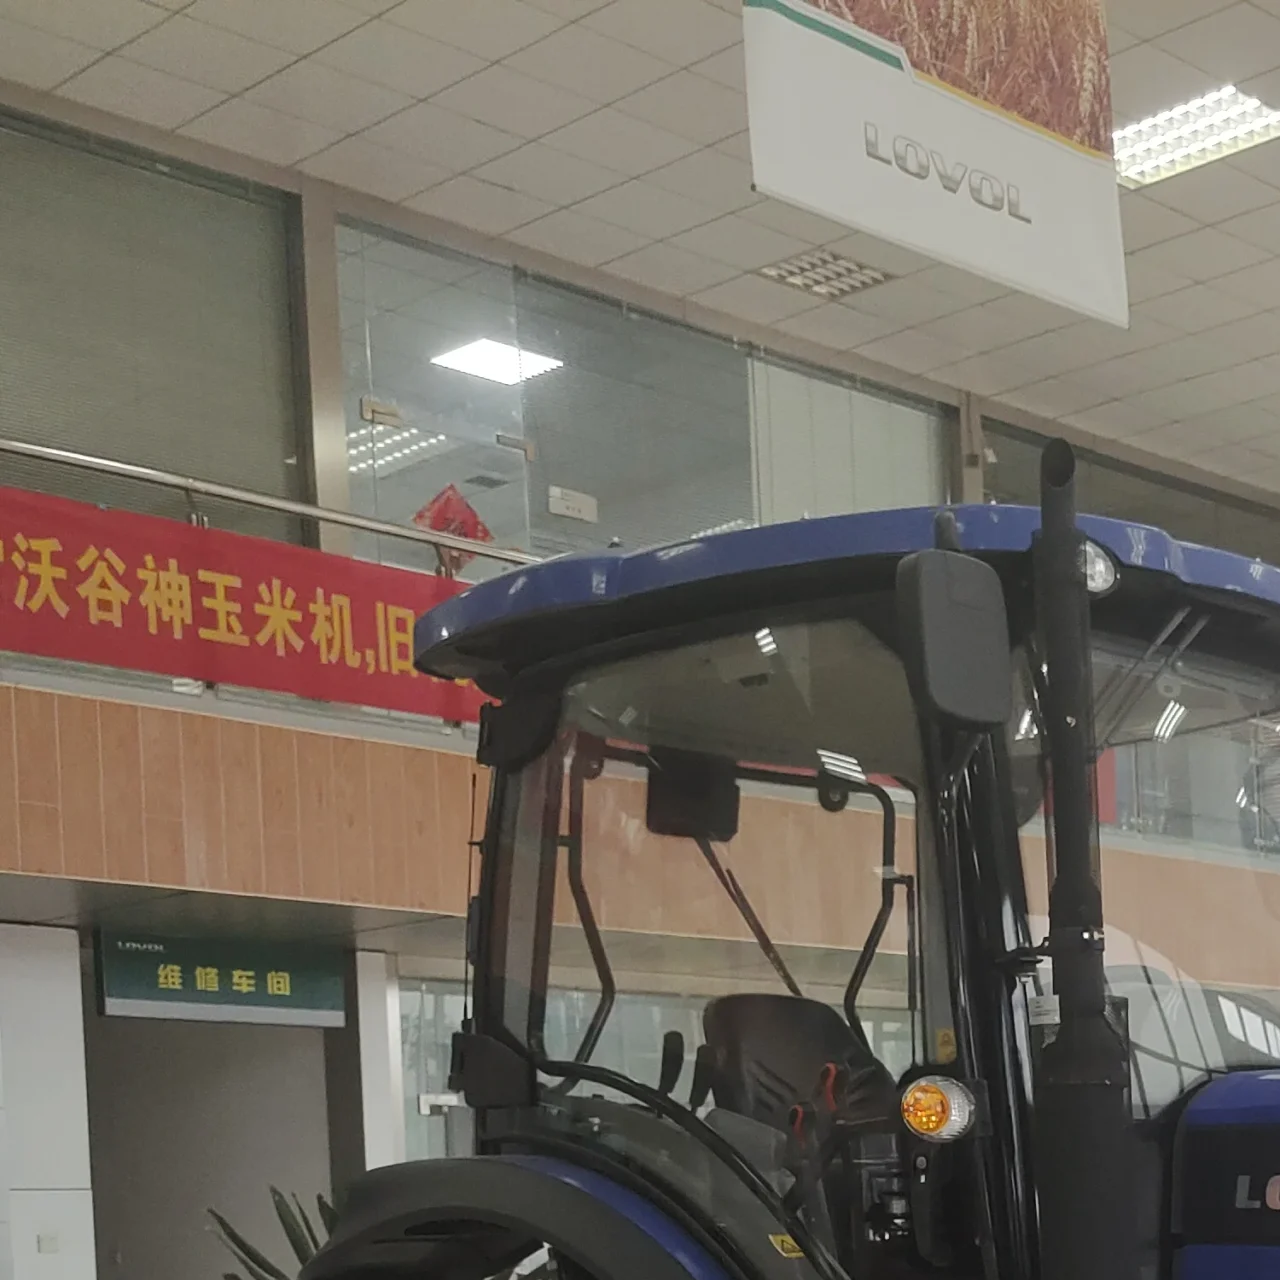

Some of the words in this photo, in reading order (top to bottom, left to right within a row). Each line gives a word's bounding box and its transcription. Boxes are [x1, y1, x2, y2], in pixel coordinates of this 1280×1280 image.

[864, 121, 1032, 224] LOVOL
[0, 532, 478, 690] 沃谷神玉米机,旧
[158, 964, 291, 996] 维修车间
